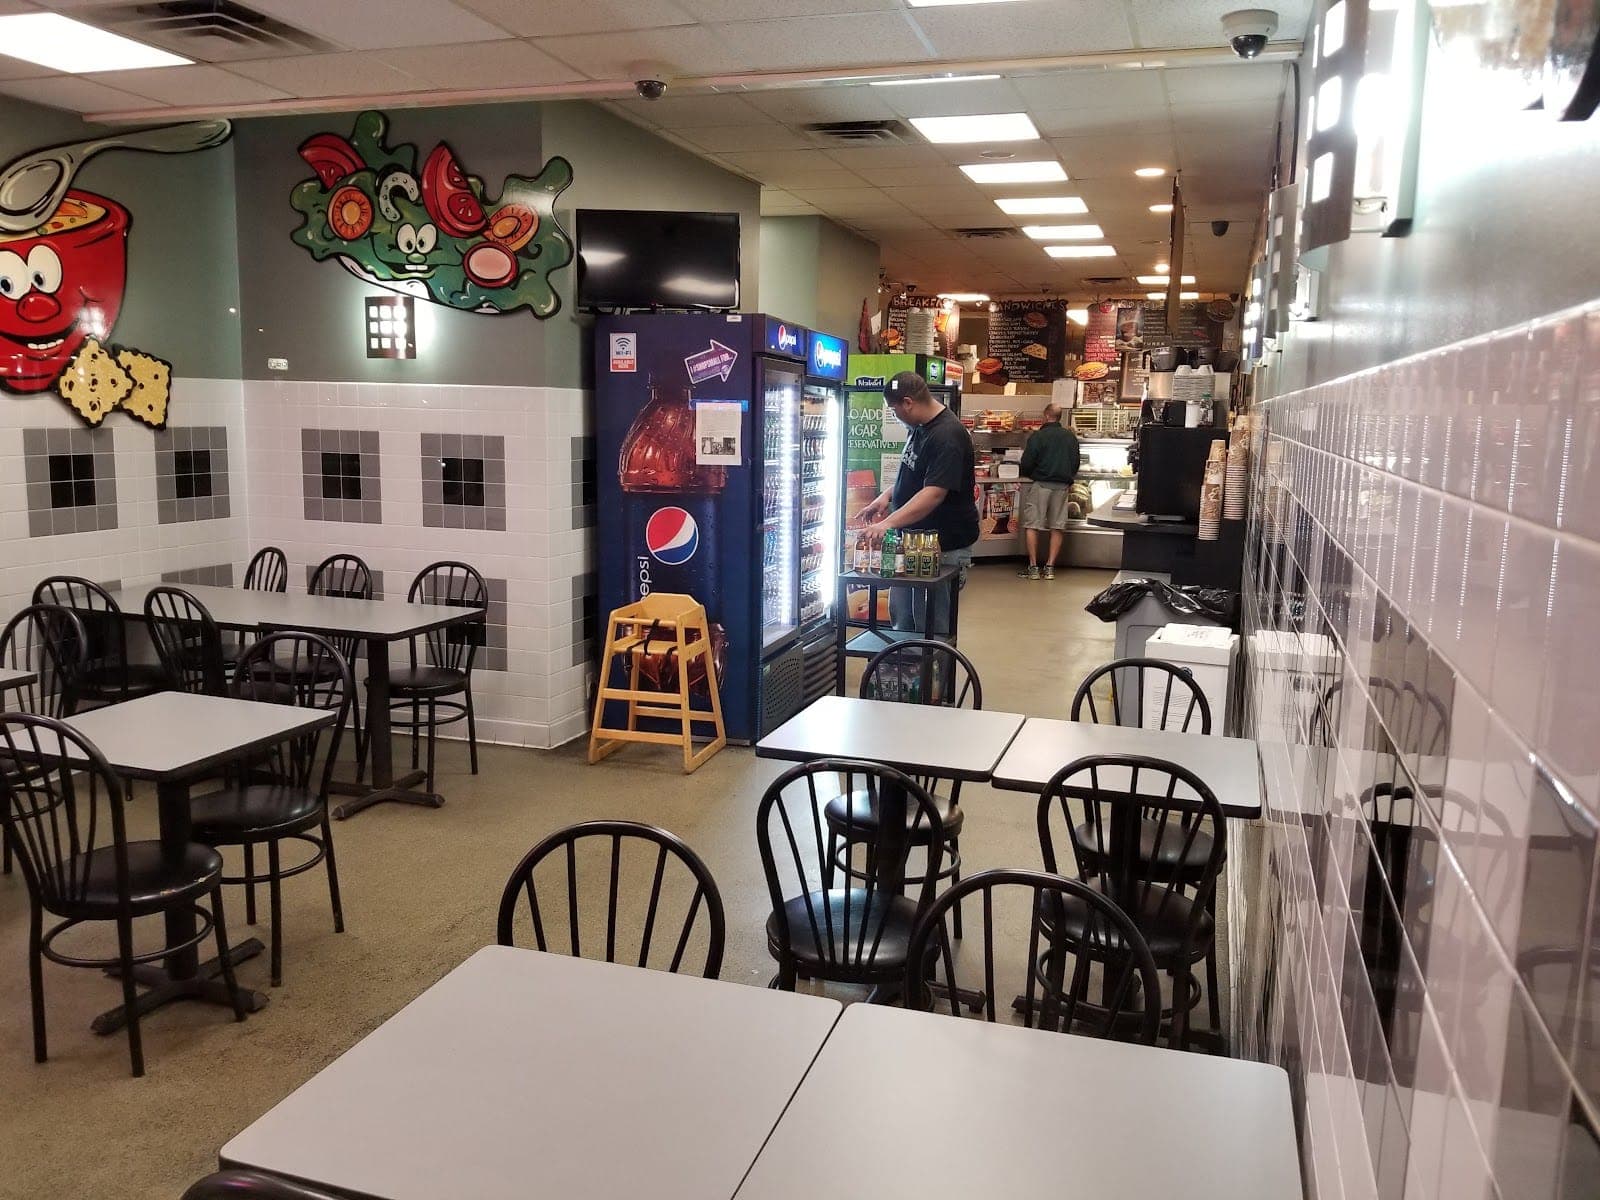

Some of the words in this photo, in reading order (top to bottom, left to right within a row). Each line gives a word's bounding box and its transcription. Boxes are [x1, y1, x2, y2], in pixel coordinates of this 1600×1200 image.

[893, 296, 951, 307] BREAKFA
[989, 301, 1065, 311] ANDWICHES
[848, 423, 878, 438] UGAR
[848, 439, 898, 449] ESERVATIVES!
[637, 555, 653, 600] epsi
